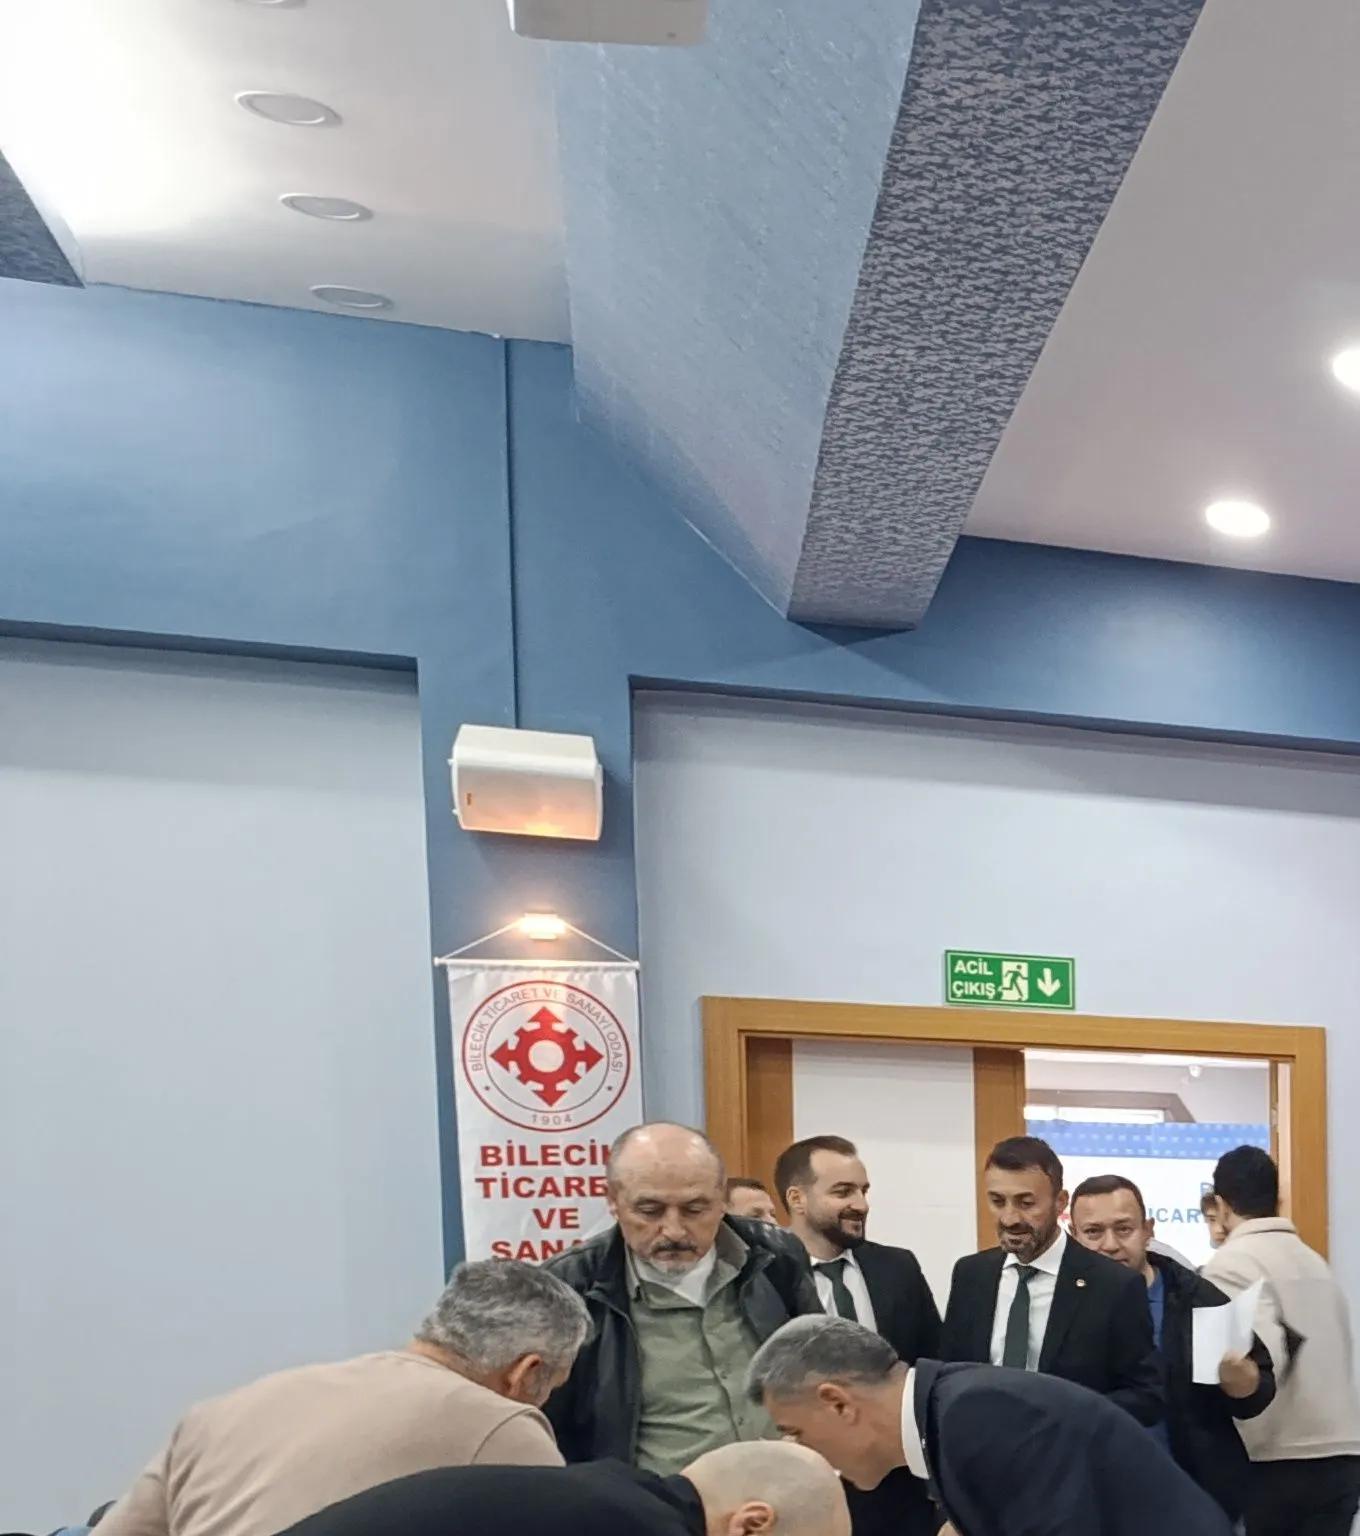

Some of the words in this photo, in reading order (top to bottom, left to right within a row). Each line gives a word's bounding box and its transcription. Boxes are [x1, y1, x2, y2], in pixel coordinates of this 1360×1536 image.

[954, 958, 993, 976] ACİL
[542, 987, 561, 999] VE
[952, 980, 996, 1000] ÇIKIŞ
[532, 1114, 573, 1125] 1904
[475, 1172, 609, 1199] TİCARE
[532, 1207, 581, 1230] VE
[491, 1239, 584, 1262] SAN
